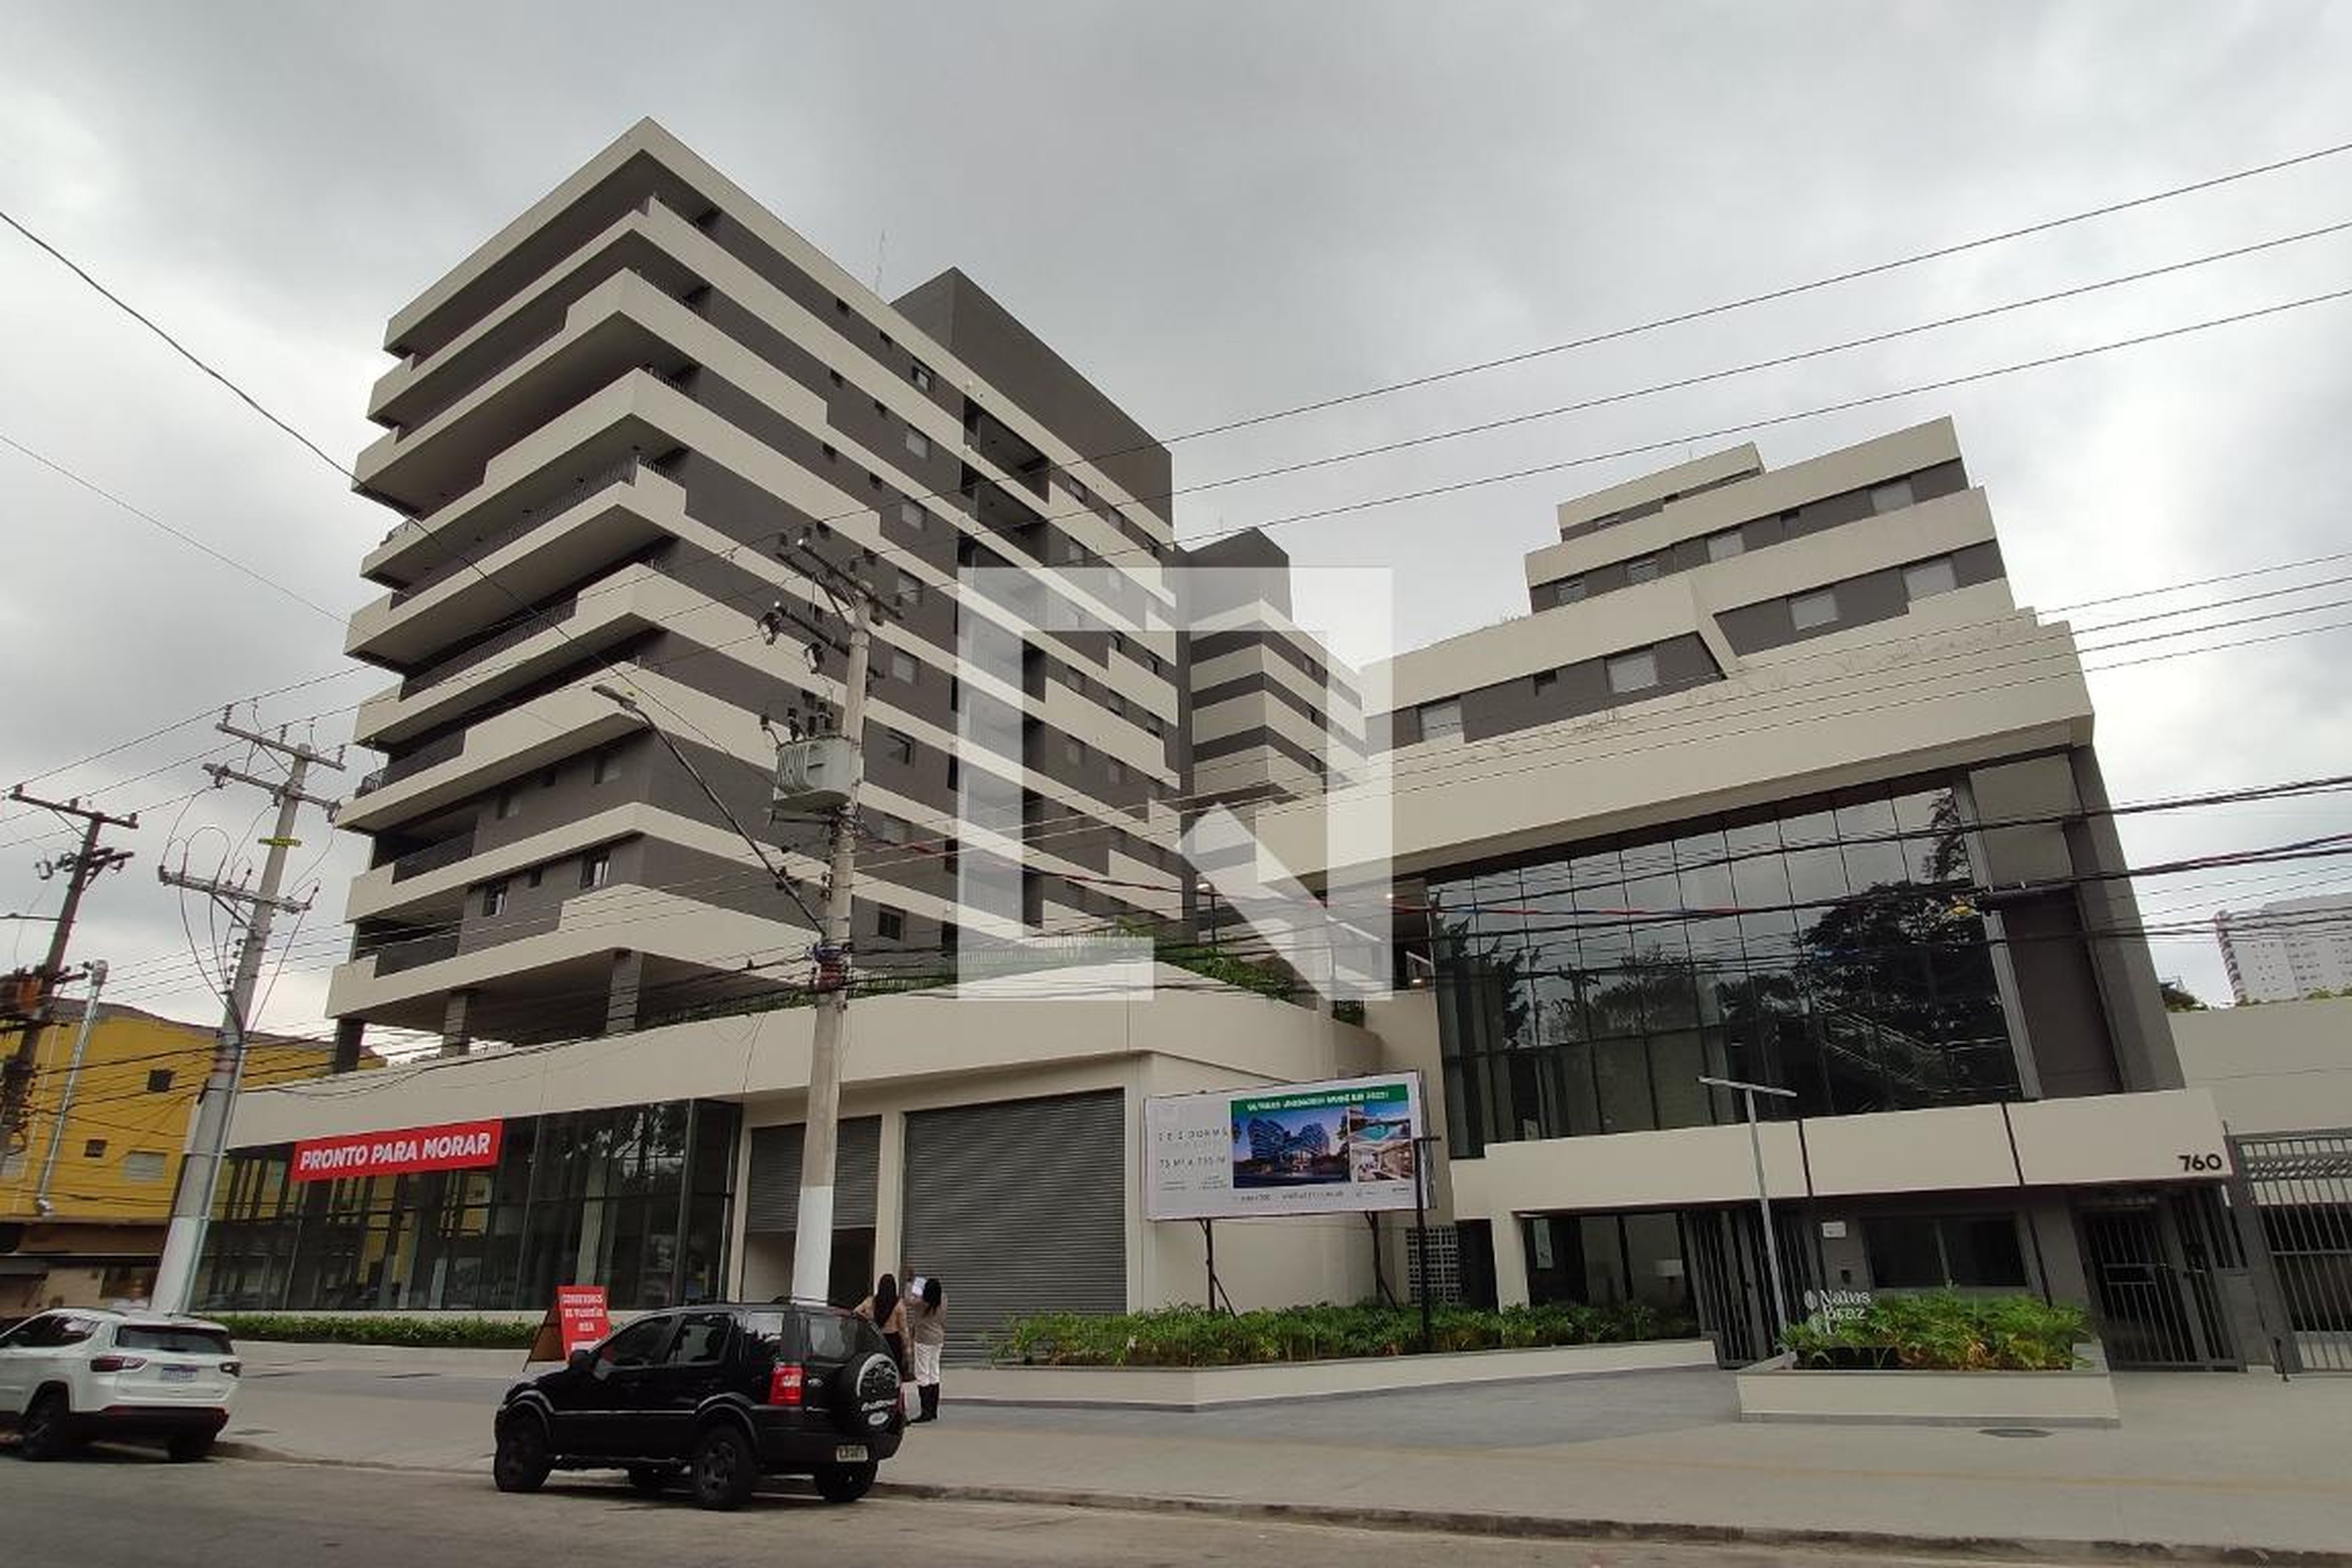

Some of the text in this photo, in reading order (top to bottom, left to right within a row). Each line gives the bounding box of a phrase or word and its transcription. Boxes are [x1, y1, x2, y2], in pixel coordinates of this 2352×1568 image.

[299, 1132, 491, 1170] PRONTO PARA MORAR
[2177, 1153, 2222, 1172] 760
